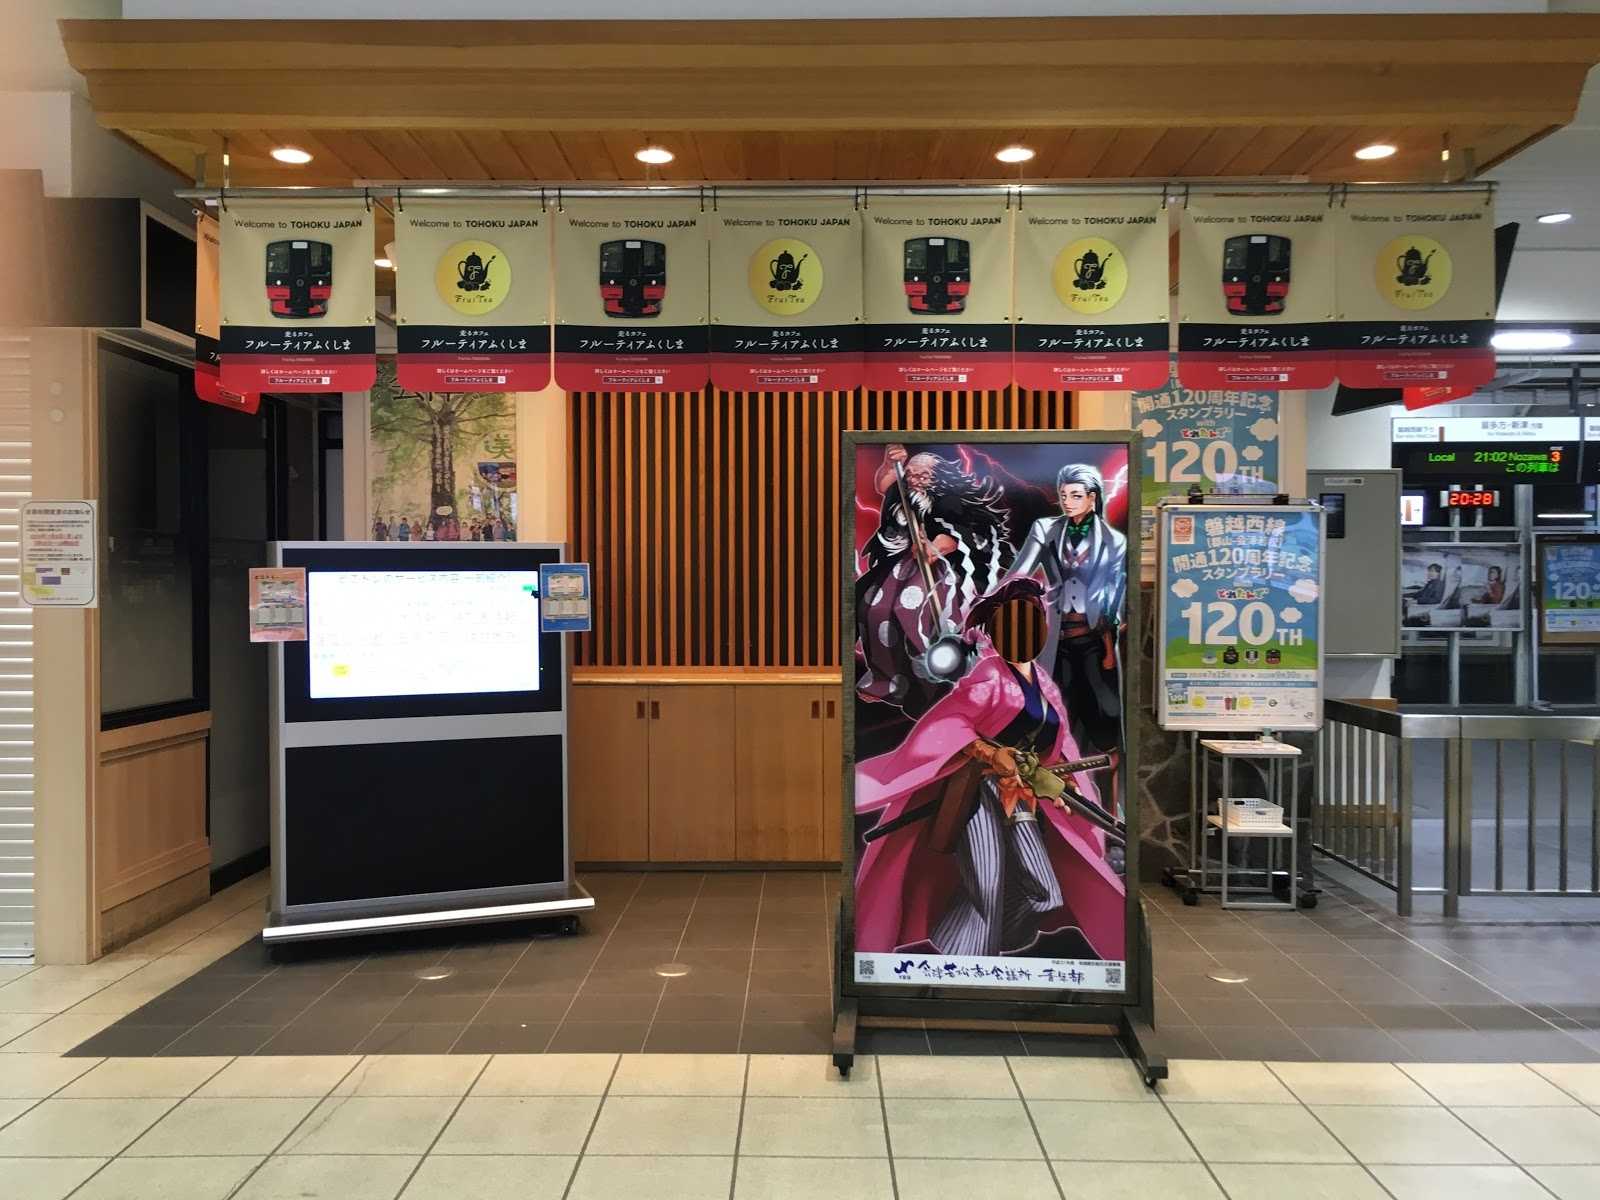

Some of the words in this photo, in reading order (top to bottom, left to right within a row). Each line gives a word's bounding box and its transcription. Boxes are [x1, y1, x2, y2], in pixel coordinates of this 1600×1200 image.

[234, 219, 275, 229] Welcome
[290, 220, 330, 229] TOHOKU
[334, 220, 362, 229] JAPAN
[410, 218, 449, 228] Welcome
[453, 220, 462, 228] to
[465, 220, 505, 228] TOHOKU
[508, 220, 538, 228] JAPAN
[569, 218, 609, 228] Welcome
[612, 220, 621, 228] to
[624, 220, 664, 228] TOHOKU
[666, 219, 696, 228] JAPAN
[723, 218, 762, 227] Welcome
[778, 218, 818, 226] TOHOKU
[820, 218, 850, 226] JAPAN
[874, 216, 913, 226] Welcome
[916, 218, 925, 226] to
[928, 218, 968, 226] TOHOKU
[970, 217, 1002, 226] JAPAN
[1028, 216, 1068, 225] Welcome
[1084, 217, 1124, 225] TOHOKU
[1126, 216, 1157, 224] JAPAN
[1193, 216, 1234, 224] Welcome
[1238, 216, 1247, 224] to
[1294, 215, 1324, 223] JAPAN
[421, 339, 528, 350] フルーティアふくしま
[579, 339, 684, 350] フルーティアふくしま
[734, 338, 839, 350] フルーティアふくしま
[883, 337, 989, 348] フルーティアふくしま
[1038, 337, 1144, 348] フルーティアふくしま
[1203, 336, 1311, 348] フルーティアふくしま
[1361, 333, 1470, 345] フルーティアふくしま
[245, 340, 352, 351] フルーティアふくしま
[1137, 389, 1273, 413] 開通120周年記念
[1428, 452, 1456, 462] Local
[1473, 452, 1507, 462] 21:02
[1508, 453, 1547, 462] Nozawa
[1551, 452, 1560, 462] 3
[1450, 492, 1493, 506] 20:28
[1204, 515, 1286, 536] 磐越西線
[1172, 548, 1313, 573] 開通120周年記念
